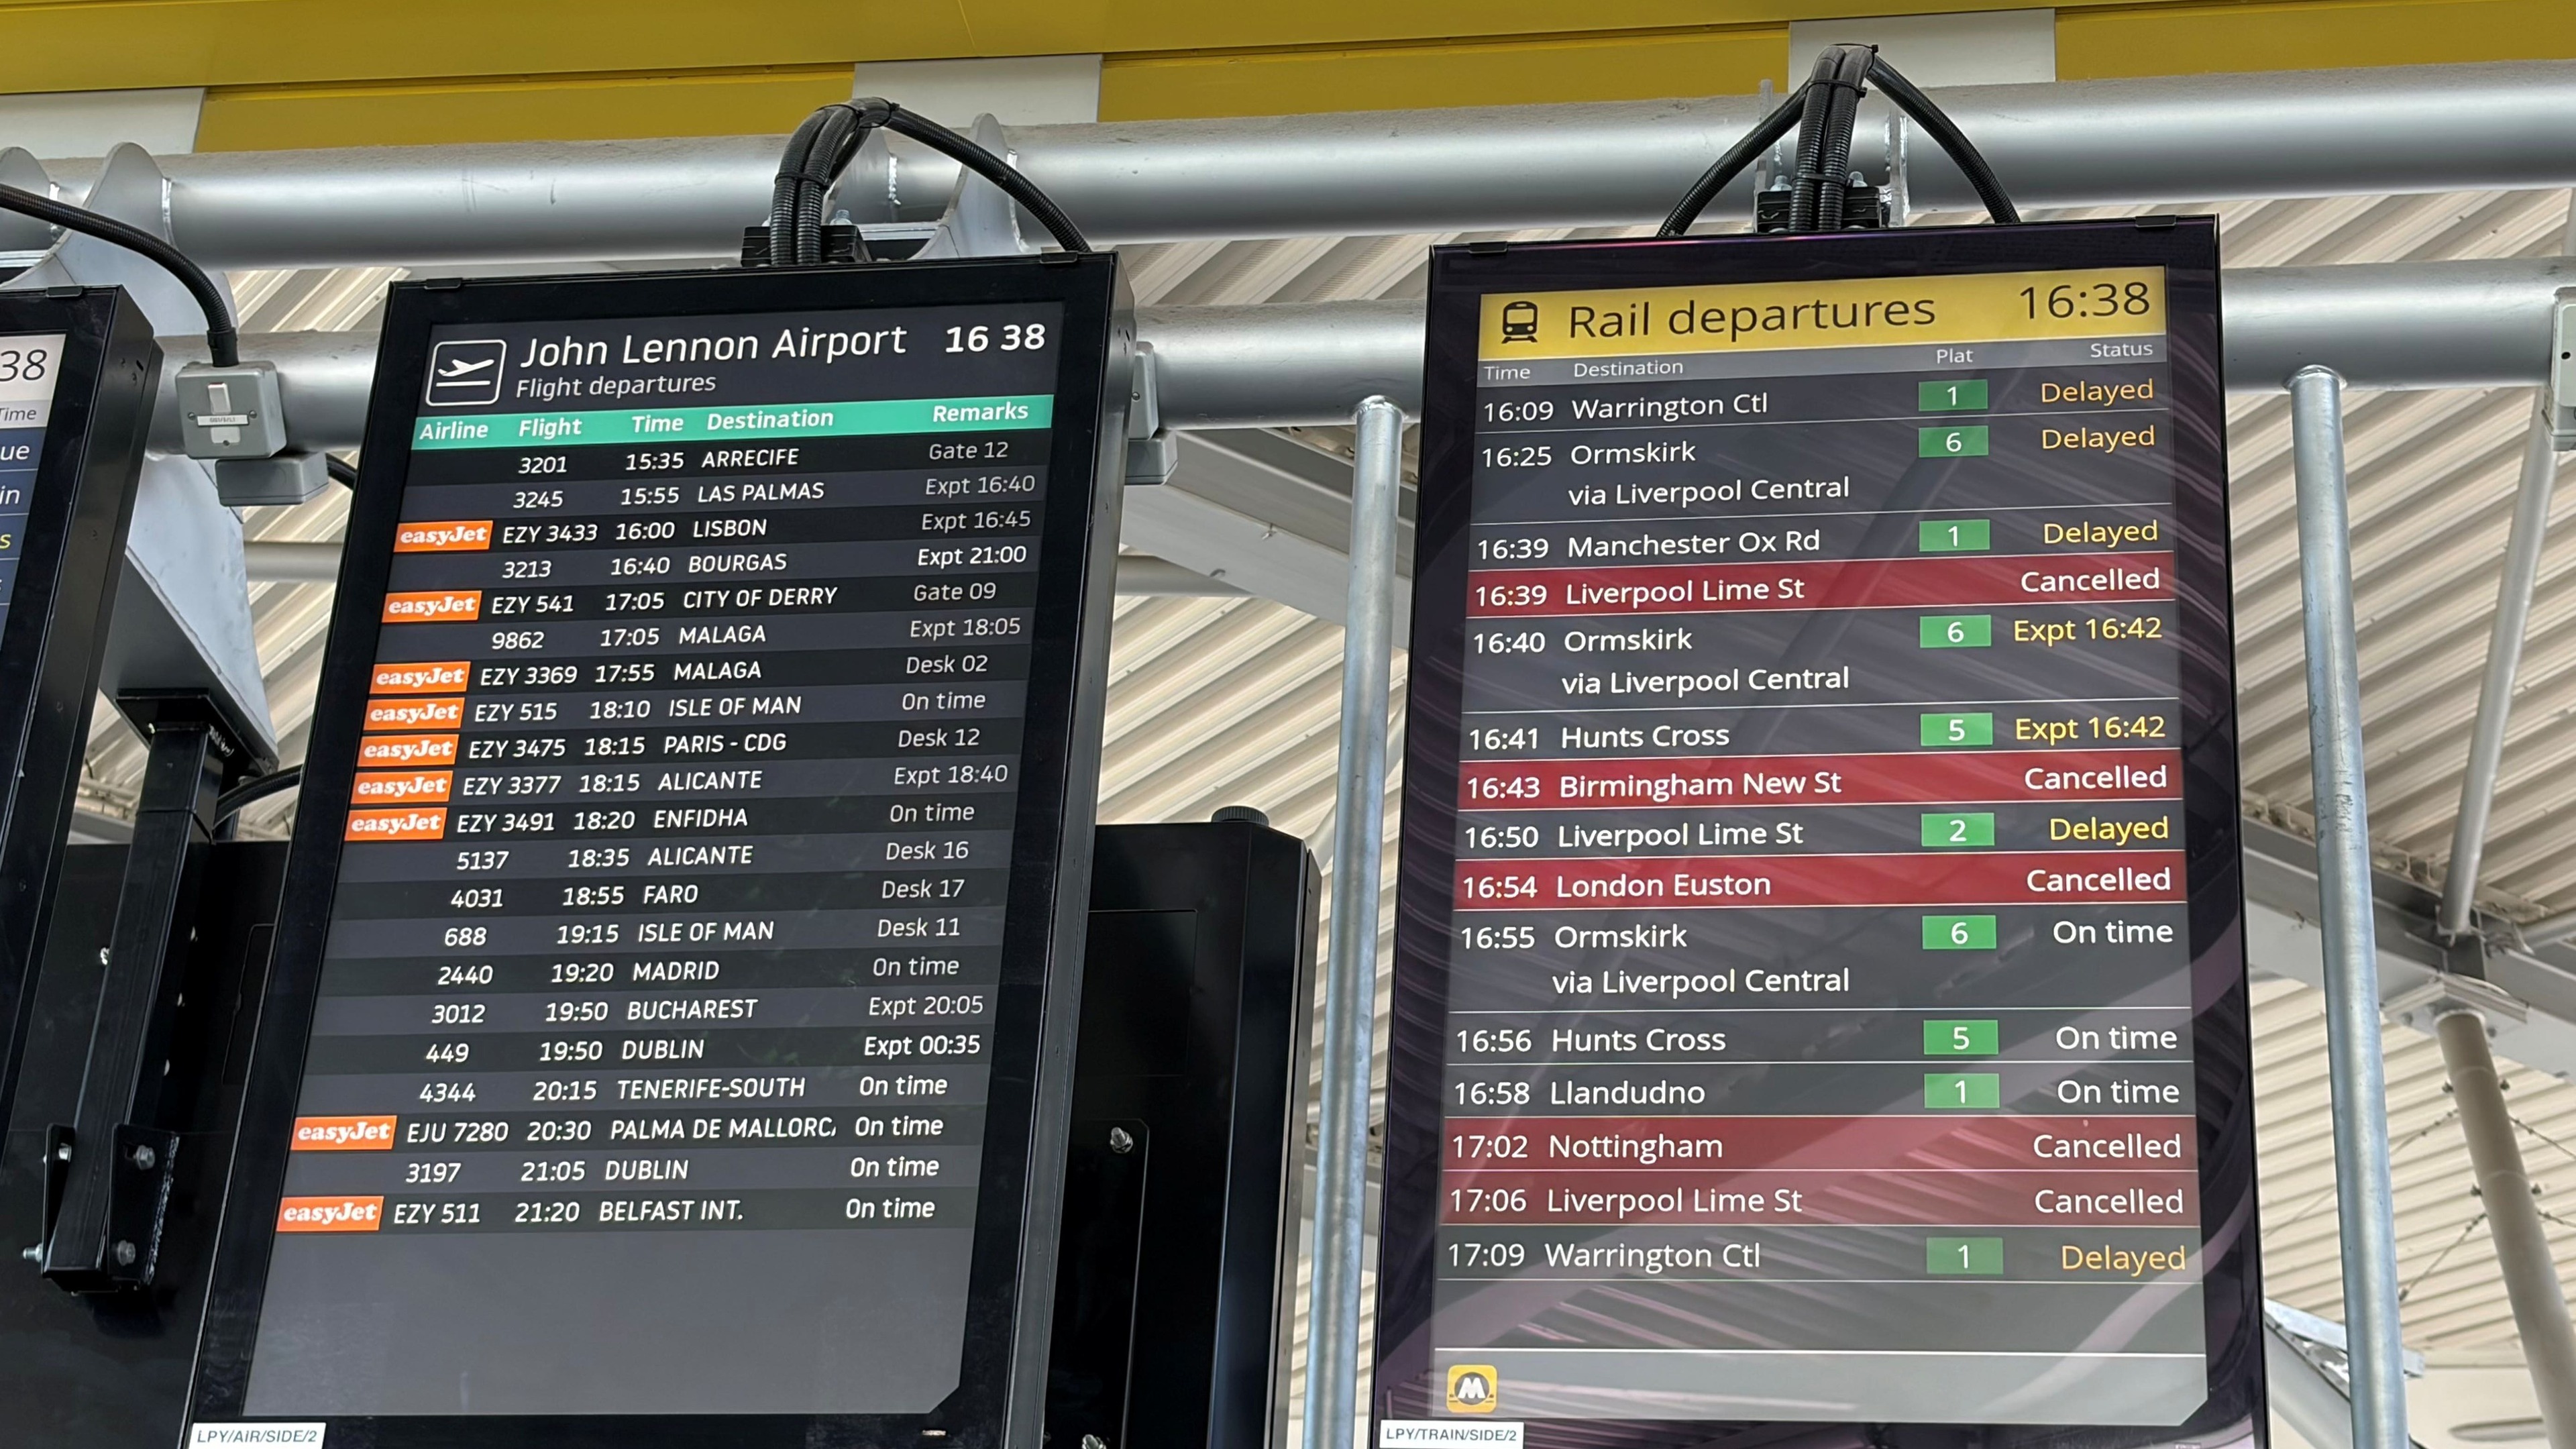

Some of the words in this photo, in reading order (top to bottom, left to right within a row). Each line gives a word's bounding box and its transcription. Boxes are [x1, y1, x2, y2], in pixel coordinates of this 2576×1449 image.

[1570, 301, 1650, 339] Rail
[1668, 299, 1935, 343] departures
[2020, 281, 2150, 320] 16:38
[520, 335, 608, 368] John
[623, 334, 759, 364] Lennon
[771, 326, 908, 364] Airport
[945, 325, 989, 353] 16
[1000, 323, 1046, 351] 38
[1483, 366, 1531, 380] Time
[1574, 360, 1683, 378] Destination
[1937, 347, 1974, 364] Plat
[2090, 343, 2153, 358] Status
[516, 376, 583, 402] Flight
[589, 375, 716, 399] departures
[1484, 400, 1554, 423] 16:09
[1571, 396, 1724, 423] Warrington
[1733, 392, 1768, 414] Ctl
[1947, 386, 1957, 407] 1
[2041, 378, 2153, 407] Delayed
[419, 421, 489, 440] Airline
[519, 417, 583, 440] Flight
[631, 414, 684, 433] Time
[707, 409, 834, 431] Destination
[932, 400, 1028, 423] Remarks
[518, 455, 568, 474] 3201
[625, 451, 684, 471] 15:35
[700, 447, 800, 468] ARRECIFE
[929, 443, 978, 460] Gate
[983, 441, 1009, 458] 12
[1482, 445, 1552, 468] 16:25
[1570, 440, 1696, 465] Ormskirk
[1946, 432, 1962, 453] 6
[2042, 424, 2155, 453] Delayed
[513, 490, 564, 509] 3245
[621, 486, 680, 506] 15:55
[698, 484, 736, 503] LAS
[741, 482, 824, 502] PALMAS
[925, 478, 971, 499] Expt
[977, 475, 1035, 494] 16:40
[1568, 484, 1606, 506] via
[1616, 479, 1741, 508] Liverpool
[1751, 475, 1849, 500] Central
[400, 526, 486, 545] easyJet
[502, 525, 542, 544] EZY
[545, 523, 598, 543] 3433
[615, 521, 676, 541] 16:00
[693, 518, 767, 538] LISBON
[922, 513, 967, 534] Expt
[973, 510, 1031, 529] 16:45
[1478, 538, 1549, 560] 16:39
[1568, 533, 1731, 558] Manchester
[1738, 531, 1777, 553] Ox
[1786, 529, 1820, 551] Rd
[1948, 525, 1957, 547] 1
[2044, 519, 2158, 548] Delayed
[388, 596, 476, 616] easyJet
[491, 596, 531, 614] EZY
[535, 594, 574, 613] 541
[605, 592, 665, 611] 17:05
[683, 590, 731, 609] CITY
[735, 589, 763, 607] OF
[768, 586, 839, 606] DERRY
[914, 584, 963, 602] Gate
[969, 582, 997, 600] 09
[376, 667, 465, 688] easyJet
[480, 667, 521, 686] EZY
[523, 665, 578, 685] 3369
[594, 663, 655, 683] 17:55
[674, 660, 762, 681] MALAGA
[906, 654, 956, 674] Desk
[962, 654, 988, 673] 02
[364, 739, 453, 761] easyJet
[468, 739, 509, 759] EZY
[512, 738, 566, 758] 3475
[584, 736, 645, 756] 18:15
[663, 734, 724, 754] PARIS
[744, 733, 787, 752] CDG
[898, 728, 948, 748] Desk
[954, 728, 980, 747] 12
[1469, 727, 1538, 751] 16:41
[1561, 727, 1644, 749] Hunts
[1652, 724, 1730, 747] Cross
[1949, 719, 1965, 741] 5
[2016, 718, 2079, 747] Expt
[2088, 715, 2166, 739] 16:42
[1467, 776, 1540, 799] 16:43
[1560, 773, 1733, 802] Birmingham
[1743, 772, 1807, 795] New
[1814, 771, 1842, 794] St
[2025, 764, 2167, 790] Cancelled
[456, 851, 510, 871] 5137
[568, 848, 630, 868] 18:35
[647, 845, 754, 866] ALICANTE
[885, 840, 936, 861] Desk
[943, 841, 969, 859] 16
[1463, 875, 1538, 899] 16:54
[1557, 873, 1664, 898] London
[1674, 873, 1770, 896] Euston
[2027, 866, 2171, 892] Cancelled
[444, 926, 487, 947] 688
[557, 924, 619, 945] 19:15
[638, 922, 684, 943] ISLE
[689, 922, 718, 942] OF
[723, 920, 774, 941] MAN
[877, 916, 928, 938] Desk
[935, 917, 961, 937] 11
[431, 1004, 486, 1024] 3012
[545, 1001, 608, 1022] 19:50
[627, 998, 759, 1020] BUCHAREST
[869, 996, 917, 1020] Expt
[923, 995, 983, 1015] 20:05
[1454, 1081, 1530, 1106] 16:58
[1551, 1079, 1705, 1105] Llandudno
[1955, 1080, 1966, 1104] 1
[2057, 1079, 2101, 1104] On
[2110, 1079, 2180, 1104] time
[298, 1121, 390, 1144] easyJet
[407, 1122, 447, 1143] EJU
[453, 1121, 509, 1142] 7280
[527, 1120, 592, 1141] 20:30
[610, 1118, 685, 1140] PALMA
[692, 1118, 722, 1139] DE
[728, 1116, 837, 1138] MALLORC
[855, 1116, 884, 1136] On
[891, 1115, 944, 1136] time
[1452, 1135, 1528, 1159] 17:02
[1550, 1133, 1723, 1165] Nottingham
[2033, 1132, 2181, 1159] Cancelled
[283, 1201, 378, 1225] easyJet
[393, 1203, 437, 1224] EZY
[441, 1203, 480, 1224] 511
[515, 1201, 580, 1223] 21:20
[599, 1200, 696, 1222] BELFAST
[700, 1199, 743, 1220] INT.
[845, 1198, 875, 1219] On
[882, 1197, 936, 1218] time
[1448, 1243, 1525, 1267] 17:09
[1544, 1242, 1712, 1275] Warrington
[1723, 1242, 1760, 1268] Ctl
[1958, 1244, 1968, 1269] 1
[2061, 1244, 2186, 1277] Delayed
[197, 1430, 317, 1443] LPY/AIR/SIDE/2
[1386, 1428, 1517, 1442] LPY/TRAIN/SIDE/2
